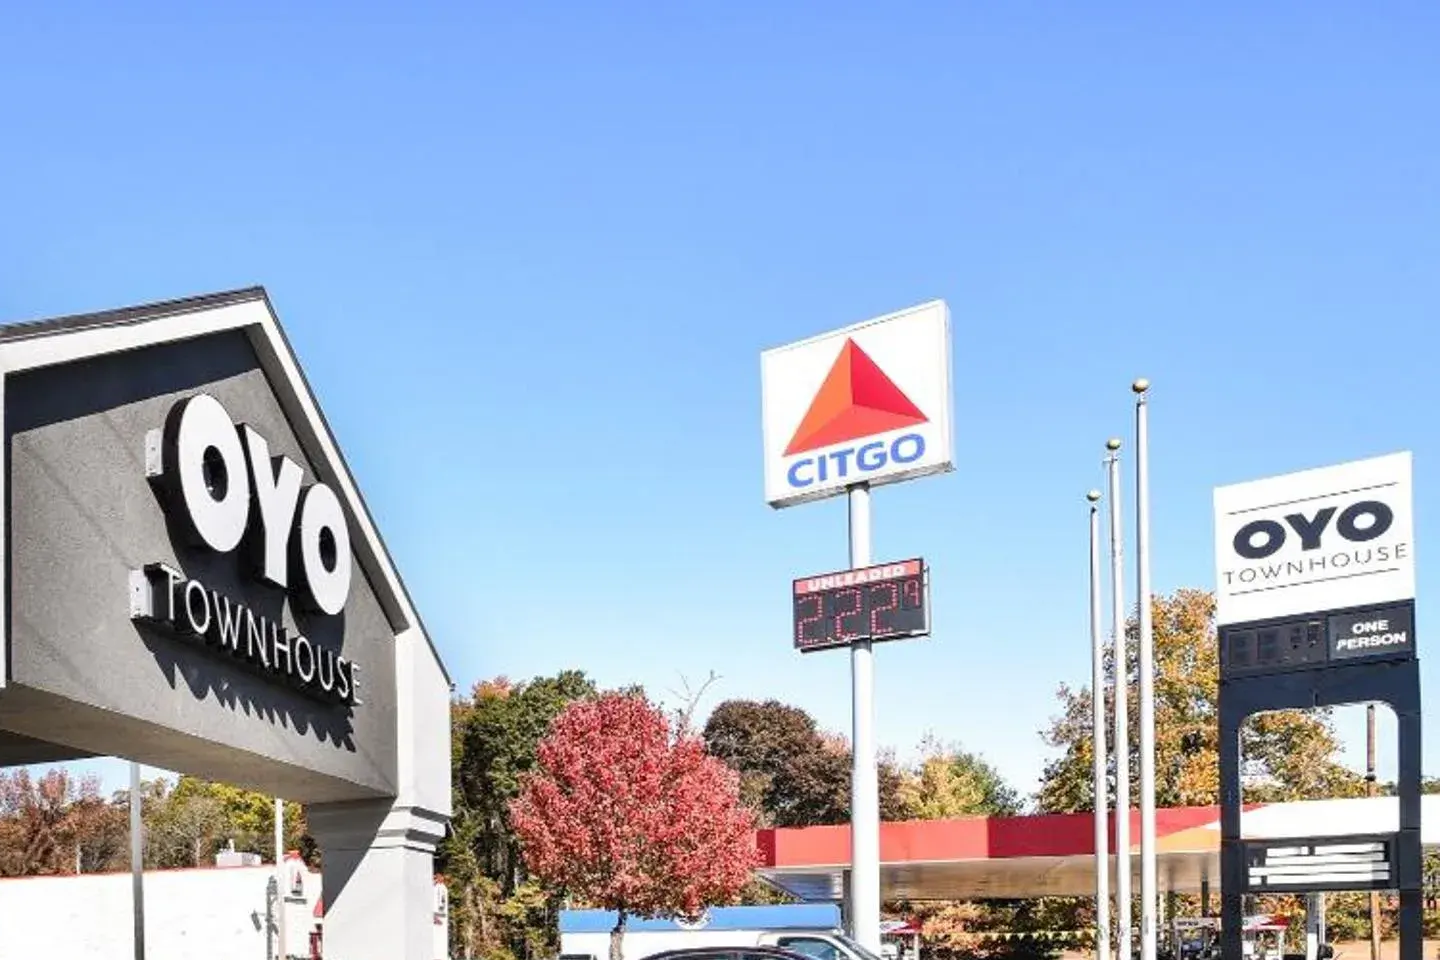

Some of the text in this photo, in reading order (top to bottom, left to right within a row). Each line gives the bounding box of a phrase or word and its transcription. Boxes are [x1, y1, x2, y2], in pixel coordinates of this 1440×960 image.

[787, 433, 926, 488] CITGO
[177, 393, 352, 615] OYO
[1232, 500, 1394, 560] OYO
[807, 566, 905, 592] UNLEADED
[1223, 543, 1407, 584] TOWNHOUSE
[160, 563, 362, 706] TOWNHOUSE
[1336, 632, 1407, 651] PERSON
[1351, 619, 1389, 634] ONE
